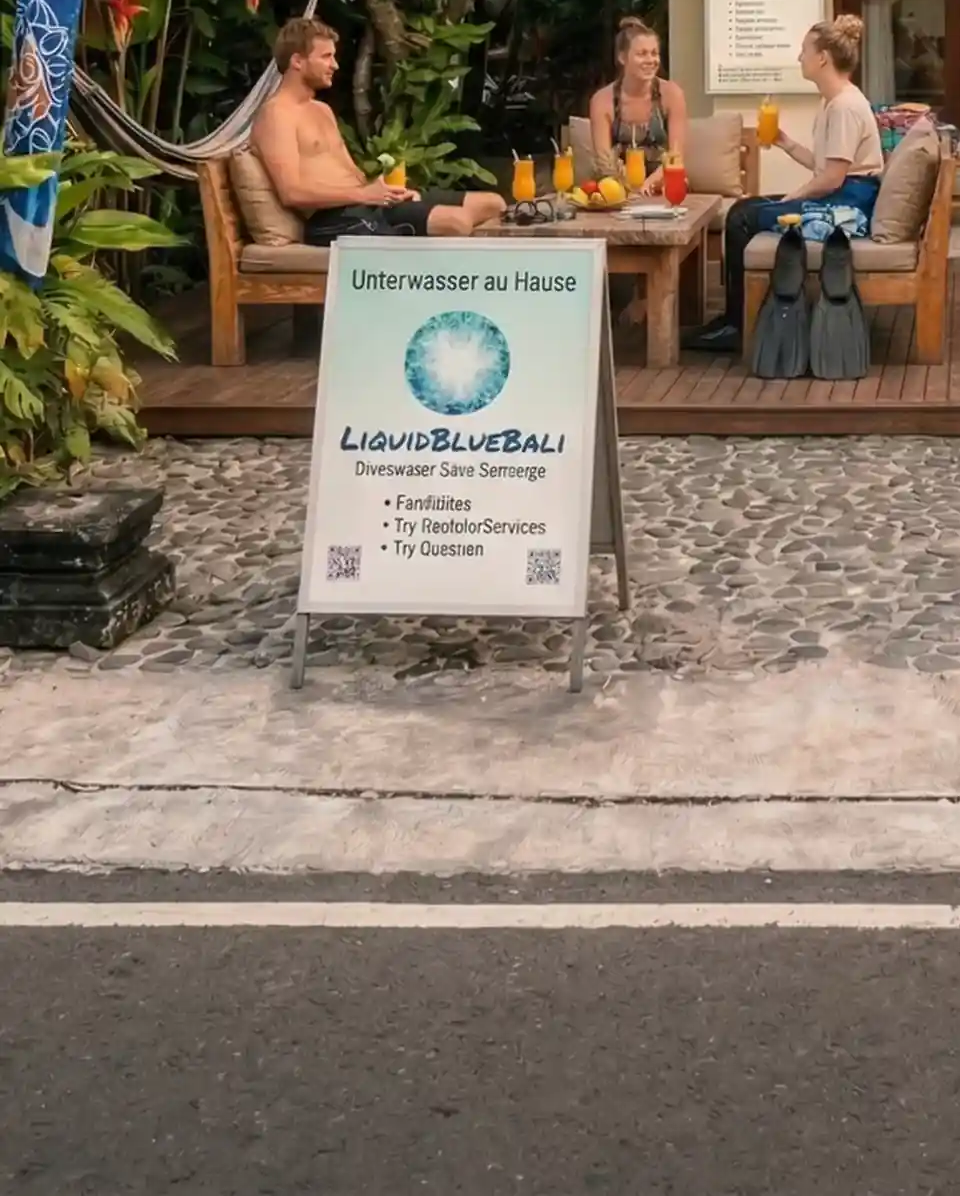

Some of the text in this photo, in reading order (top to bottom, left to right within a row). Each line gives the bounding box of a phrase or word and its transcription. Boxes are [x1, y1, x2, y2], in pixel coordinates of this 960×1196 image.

[352, 268, 578, 293] Unterwasser au Hause
[394, 517, 417, 537] Try
[393, 539, 416, 560] Try
